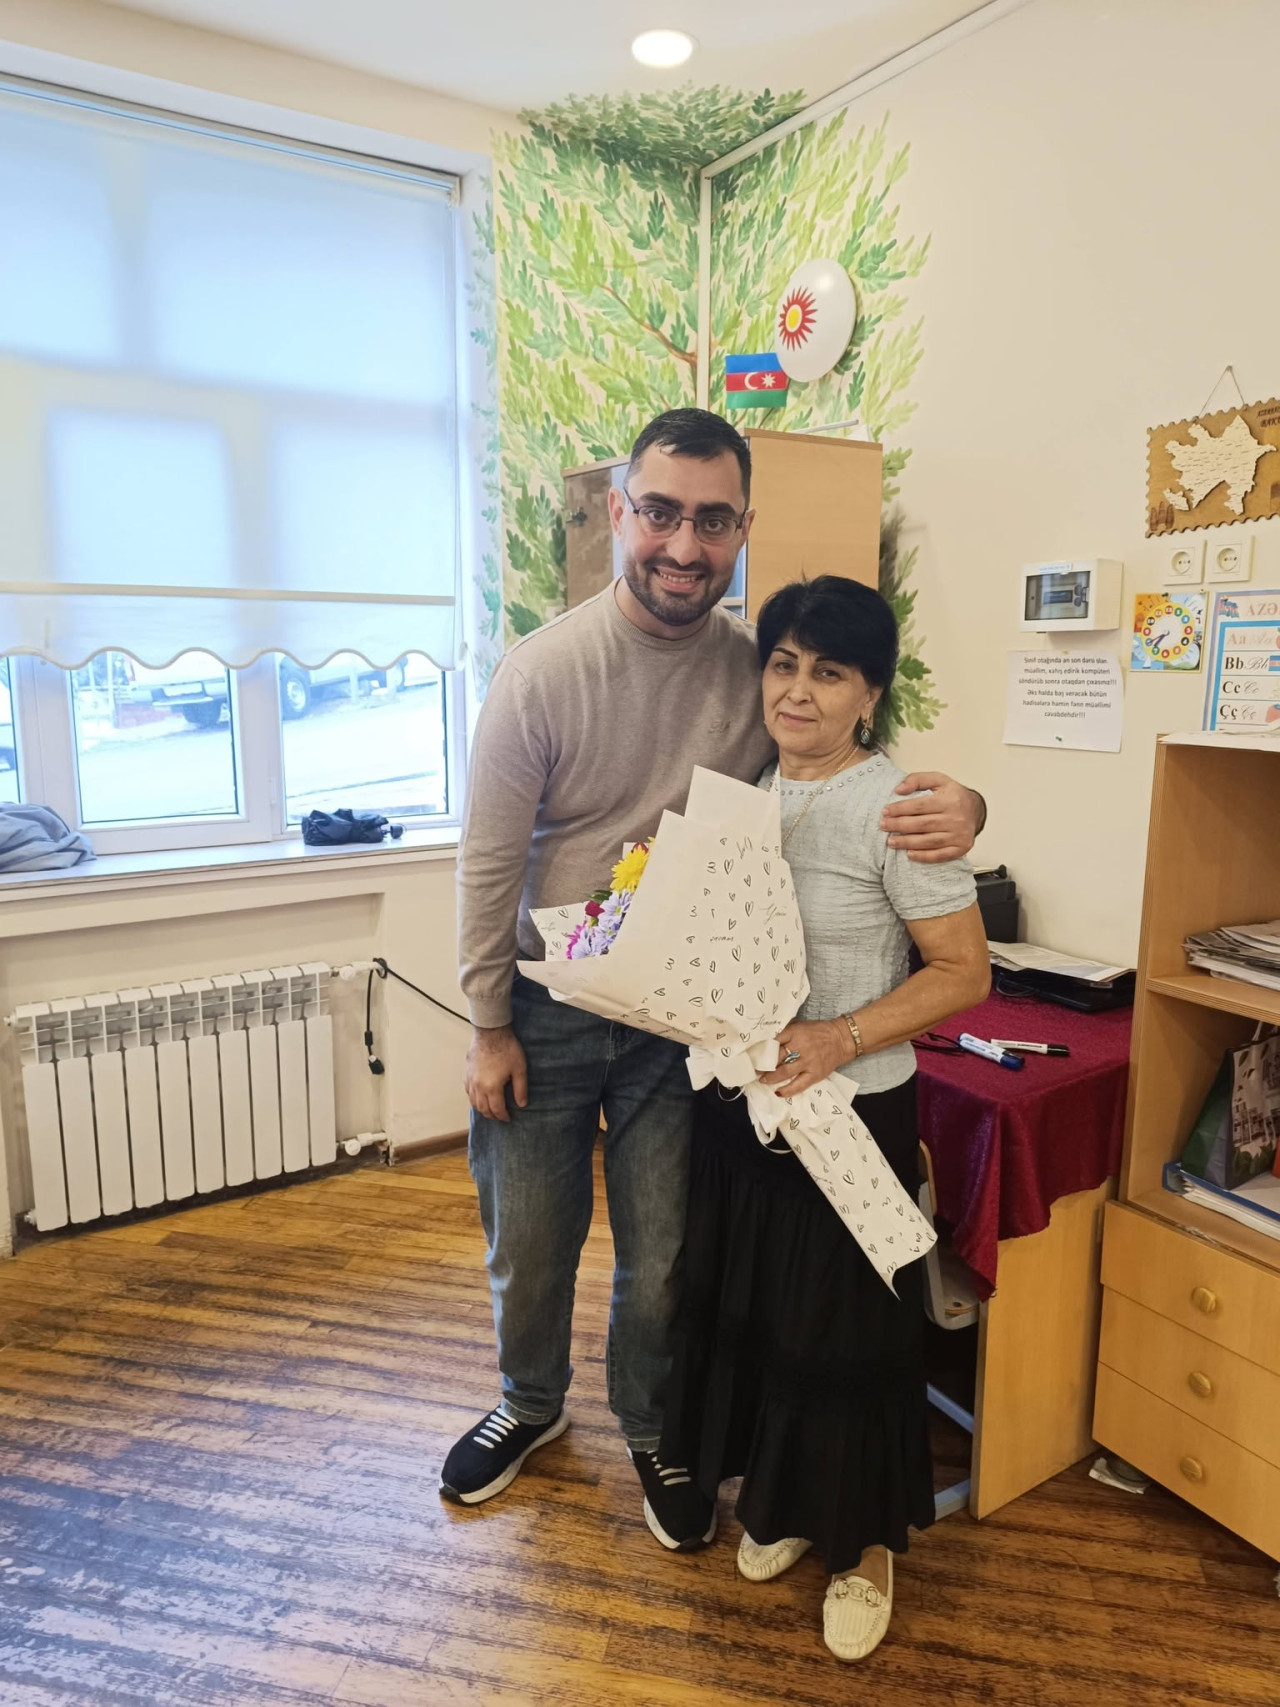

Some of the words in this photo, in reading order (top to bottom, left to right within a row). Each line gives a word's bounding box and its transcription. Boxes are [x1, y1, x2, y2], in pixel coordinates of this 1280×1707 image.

[1248, 602, 1280, 617] AZƏ
[1225, 657, 1244, 670] Bb
[1222, 681, 1241, 694] Cc
[1219, 704, 1238, 720] Çç
